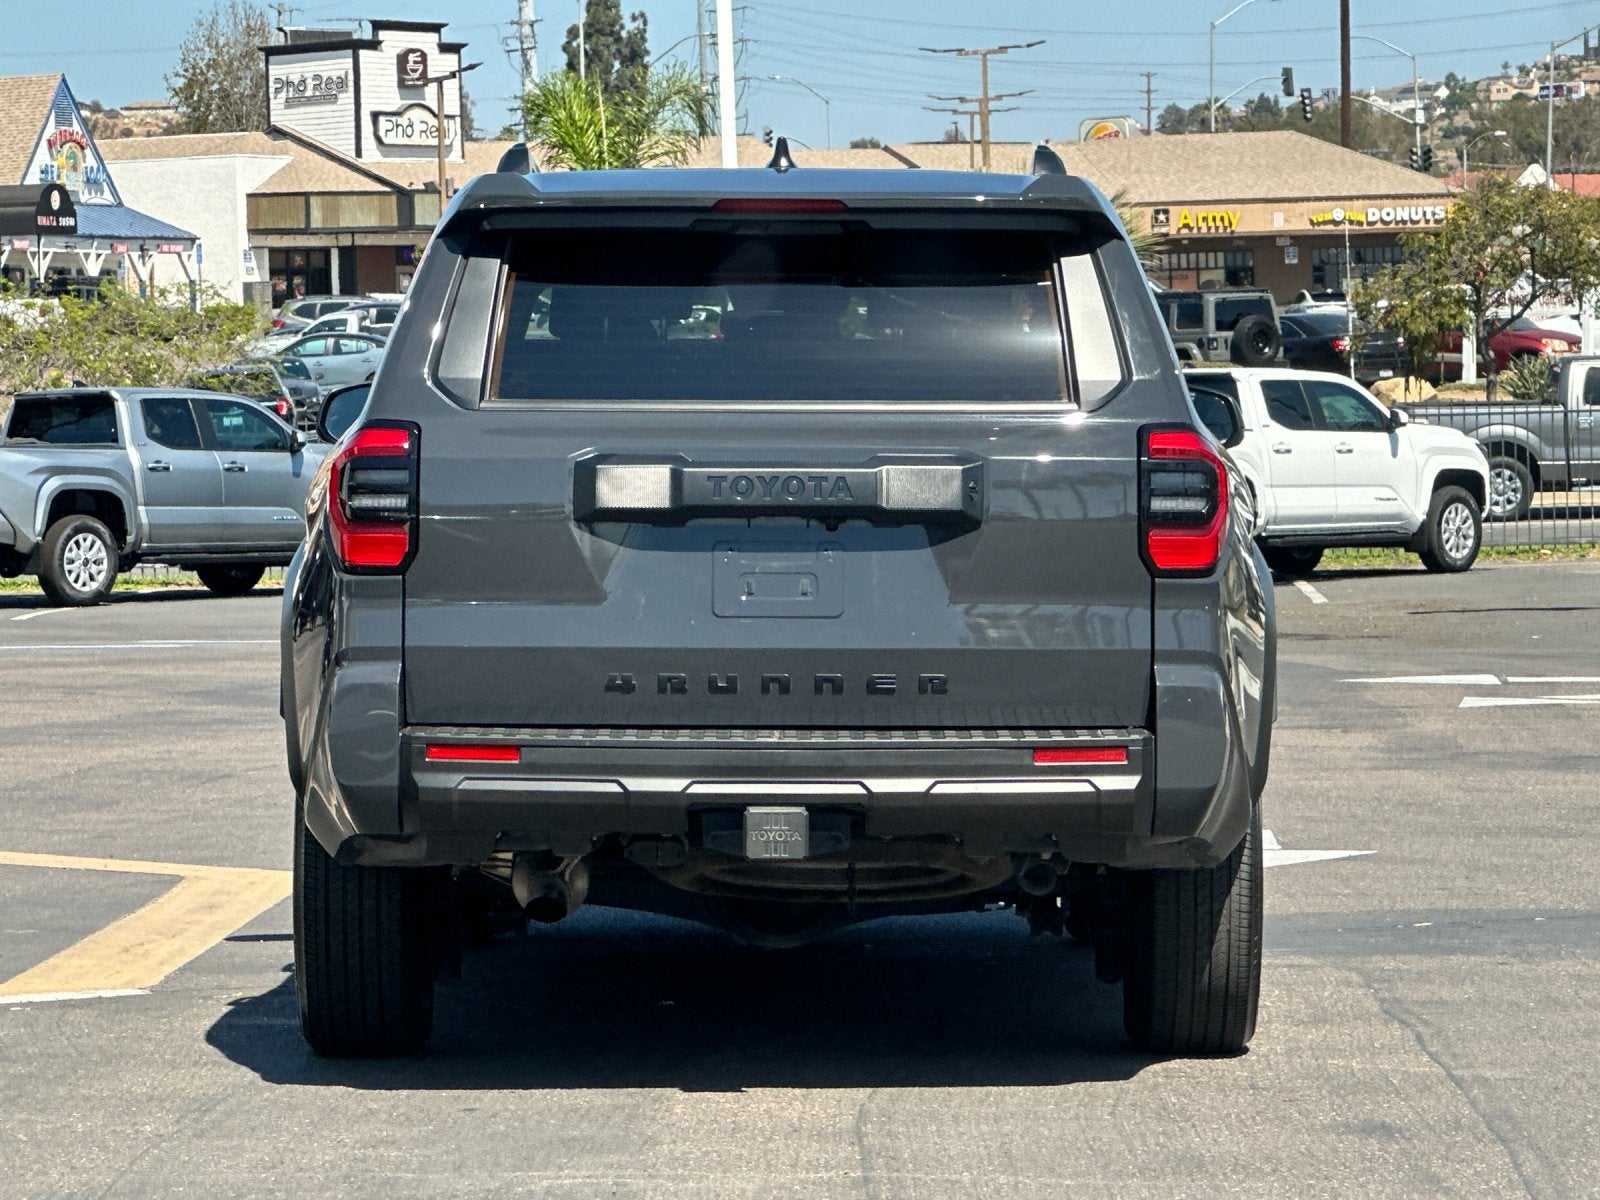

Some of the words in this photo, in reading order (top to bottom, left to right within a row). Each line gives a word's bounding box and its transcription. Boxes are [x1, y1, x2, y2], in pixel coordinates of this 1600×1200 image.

[312, 70, 348, 91] Real
[419, 119, 450, 140] Rel
[58, 216, 75, 227] SUSHI
[1178, 208, 1242, 232] Army
[1311, 211, 1333, 223] YUM
[1367, 205, 1446, 222] DONUTS
[707, 475, 855, 501] TOYOTA
[604, 672, 949, 695] 4RUNNER
[749, 830, 803, 841] TOYOTA
